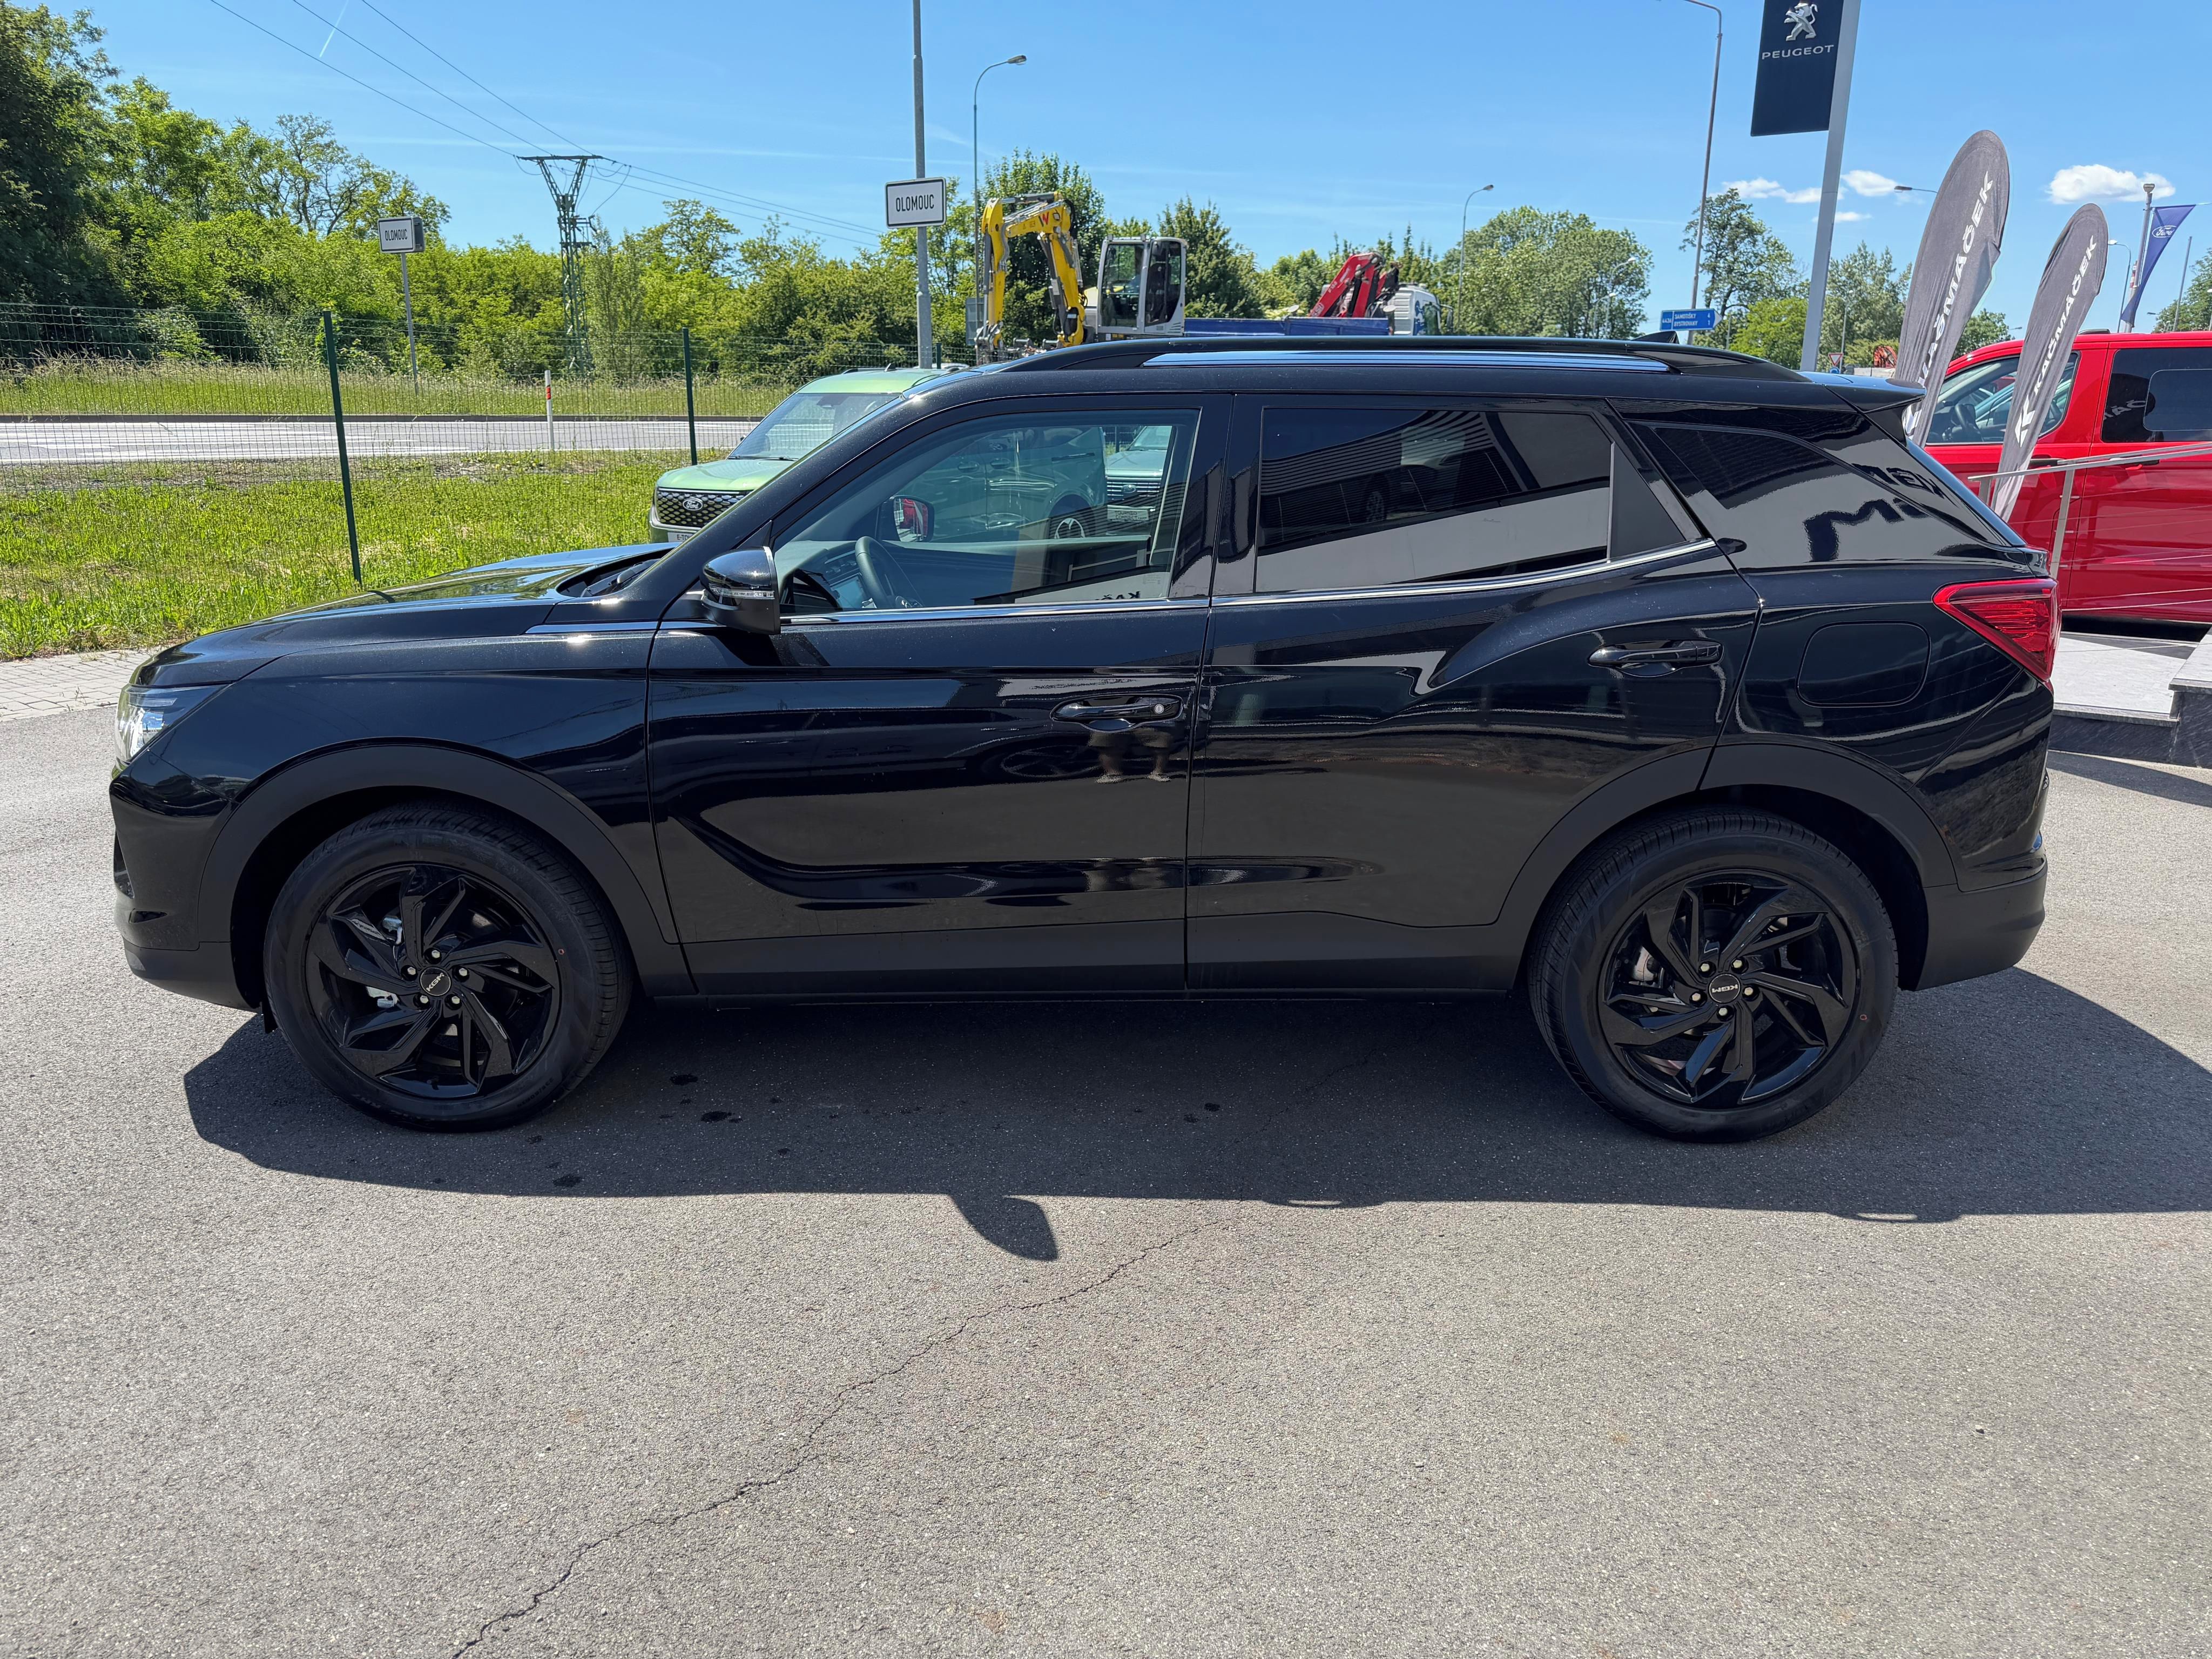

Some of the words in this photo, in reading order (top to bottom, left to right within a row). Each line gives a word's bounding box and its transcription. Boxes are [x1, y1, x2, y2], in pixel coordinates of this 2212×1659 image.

[1762, 44, 1834, 60] PEUGEOT
[895, 194, 934, 212] OLOMOUC
[385, 229, 408, 241] OLOMOUC
[426, 972, 444, 992] KGM
[1711, 984, 1738, 993] KGM
